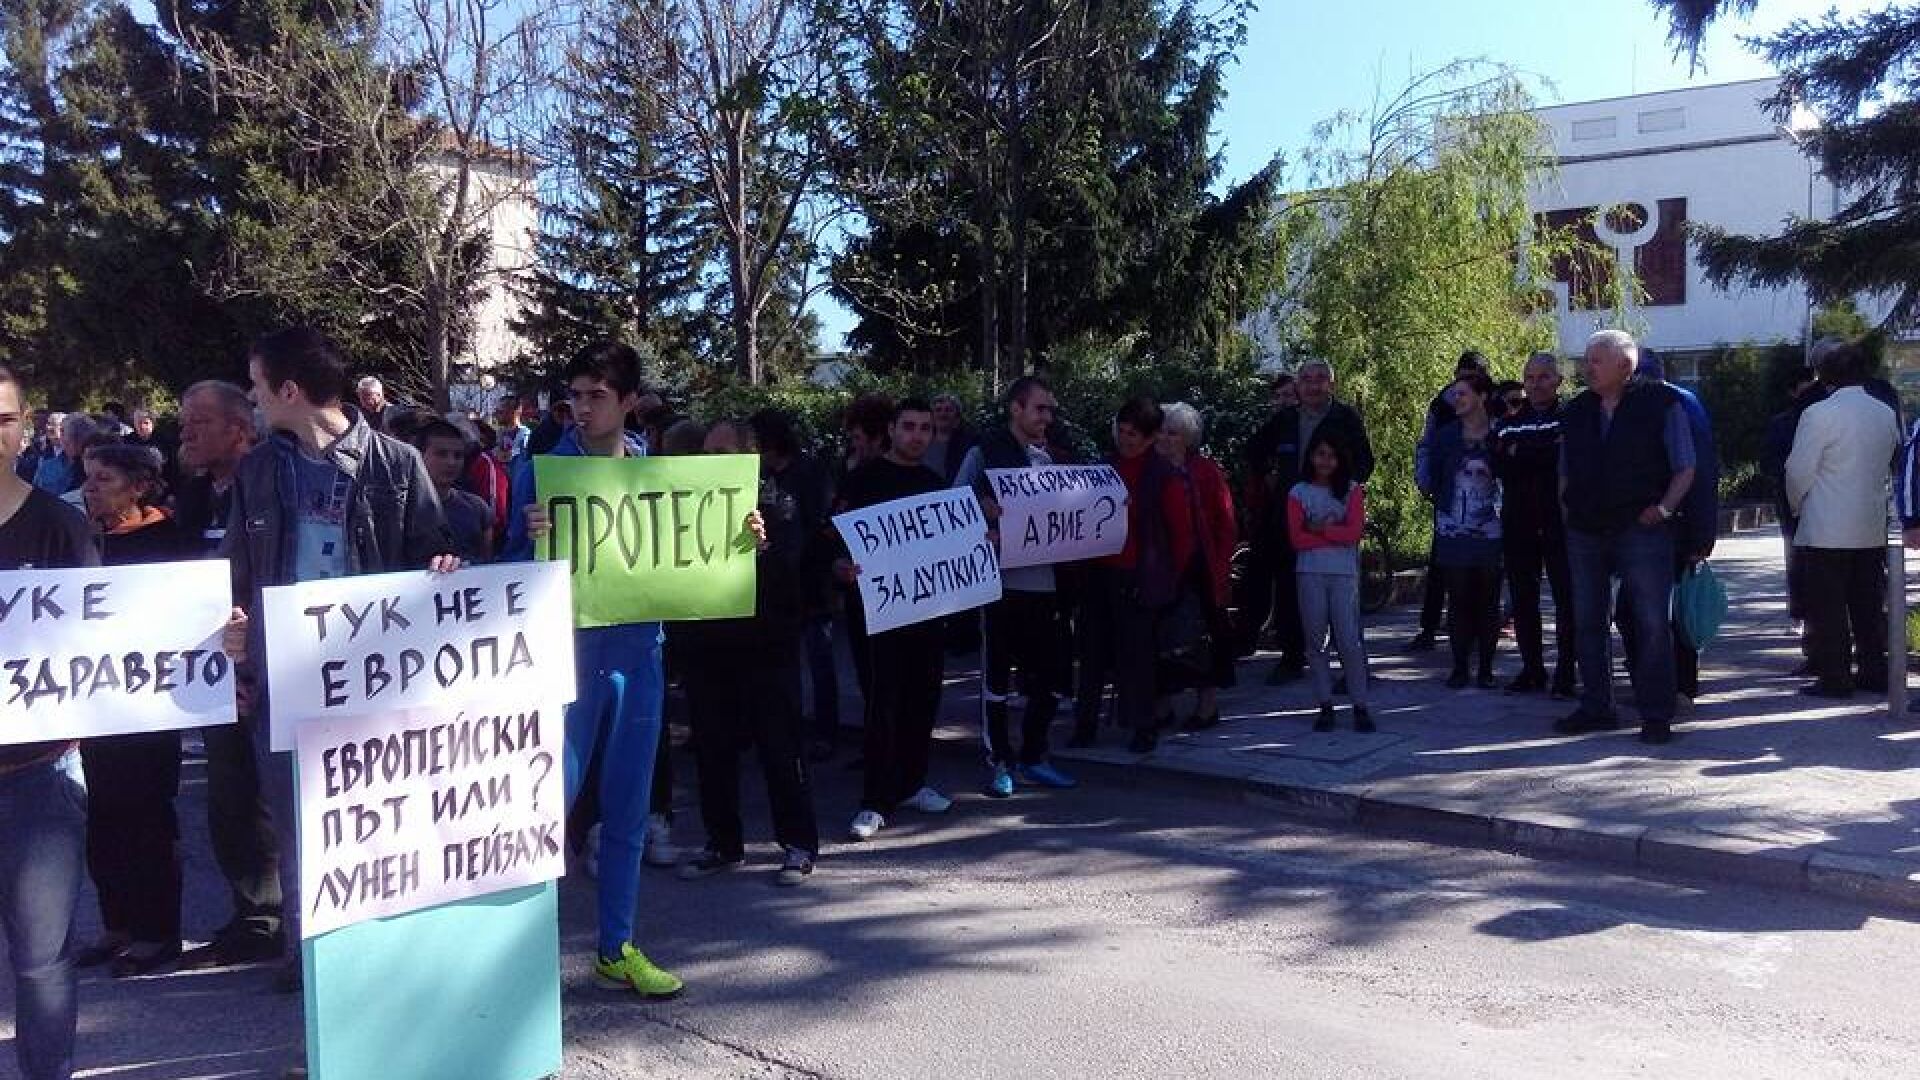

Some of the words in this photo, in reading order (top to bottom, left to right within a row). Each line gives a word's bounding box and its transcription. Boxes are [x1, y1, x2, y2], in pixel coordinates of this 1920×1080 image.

[549, 487, 742, 575] ПРОТЕСТ
[853, 497, 979, 556] ВИНЕТКИ
[1023, 513, 1040, 547] А
[82, 582, 116, 620] Е
[304, 596, 411, 642] ТУК
[433, 587, 486, 625] НЕ
[505, 581, 526, 616] Е
[871, 571, 907, 613] ЗА
[3, 650, 228, 711] ЗДРАВЕТО
[321, 631, 534, 708] ЕВРОПА
[321, 709, 541, 799] ЕВРОПЕЙСКИ
[321, 794, 410, 855] ПЪТ
[431, 773, 511, 825] ИЛИ
[528, 751, 553, 812] ?
[311, 850, 419, 917] ЛУНЕН
[443, 822, 559, 884] ПЕЙЗАЖ
